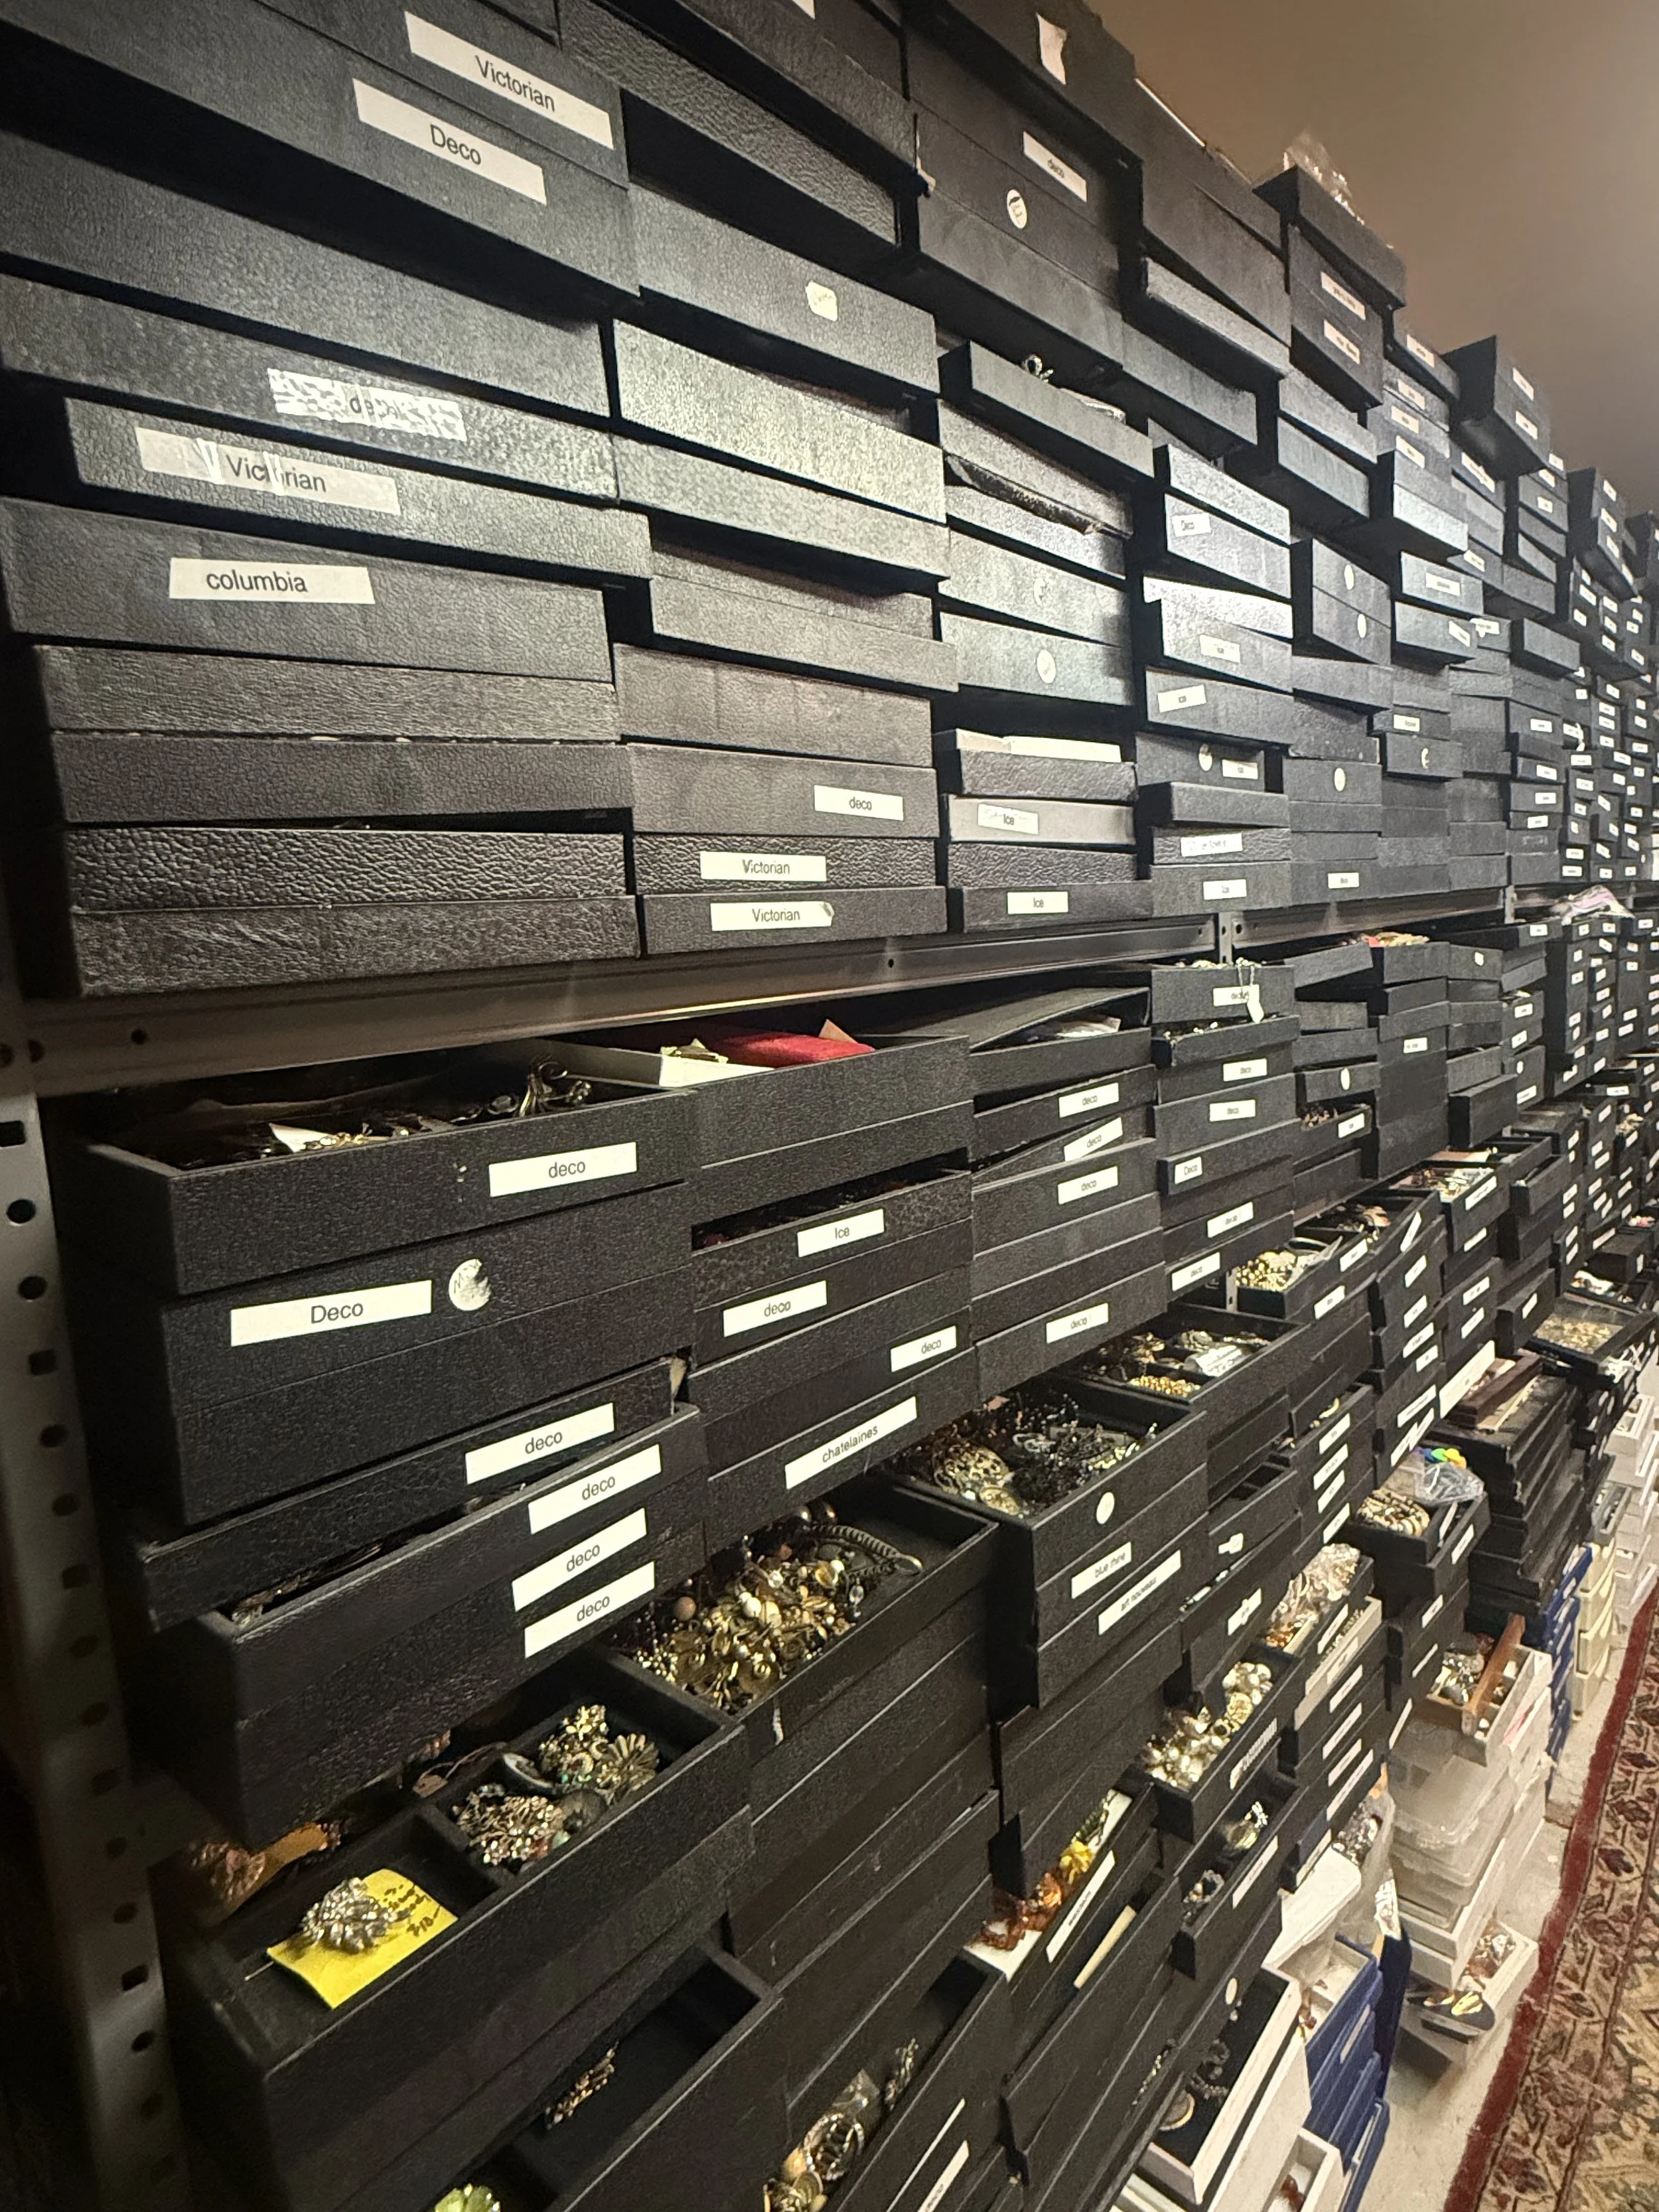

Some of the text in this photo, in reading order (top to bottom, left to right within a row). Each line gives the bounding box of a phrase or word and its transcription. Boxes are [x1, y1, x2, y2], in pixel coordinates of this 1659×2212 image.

[475, 55, 556, 112] Victorian
[429, 124, 482, 165] Deco
[226, 453, 326, 492] Victrian
[206, 569, 309, 593] columbia
[849, 796, 872, 811] deco
[742, 859, 790, 875] Victorian
[1033, 897, 1044, 908] Ice
[752, 908, 800, 922] Victorian
[1082, 1095, 1098, 1106] deco
[1086, 1134, 1102, 1149] deco
[548, 1161, 586, 1179] deco
[1081, 1180, 1097, 1192] deco
[835, 1226, 850, 1240] Ice
[311, 1303, 364, 1324] Deco
[764, 1301, 792, 1317] deco
[1070, 1317, 1088, 1330] deco
[921, 1339, 942, 1355] deco
[525, 1432, 563, 1455] deco
[822, 1425, 879, 1463] chatelaines
[581, 1476, 616, 1501] deco
[566, 1544, 601, 1572] deco
[576, 1595, 611, 1622] deco
